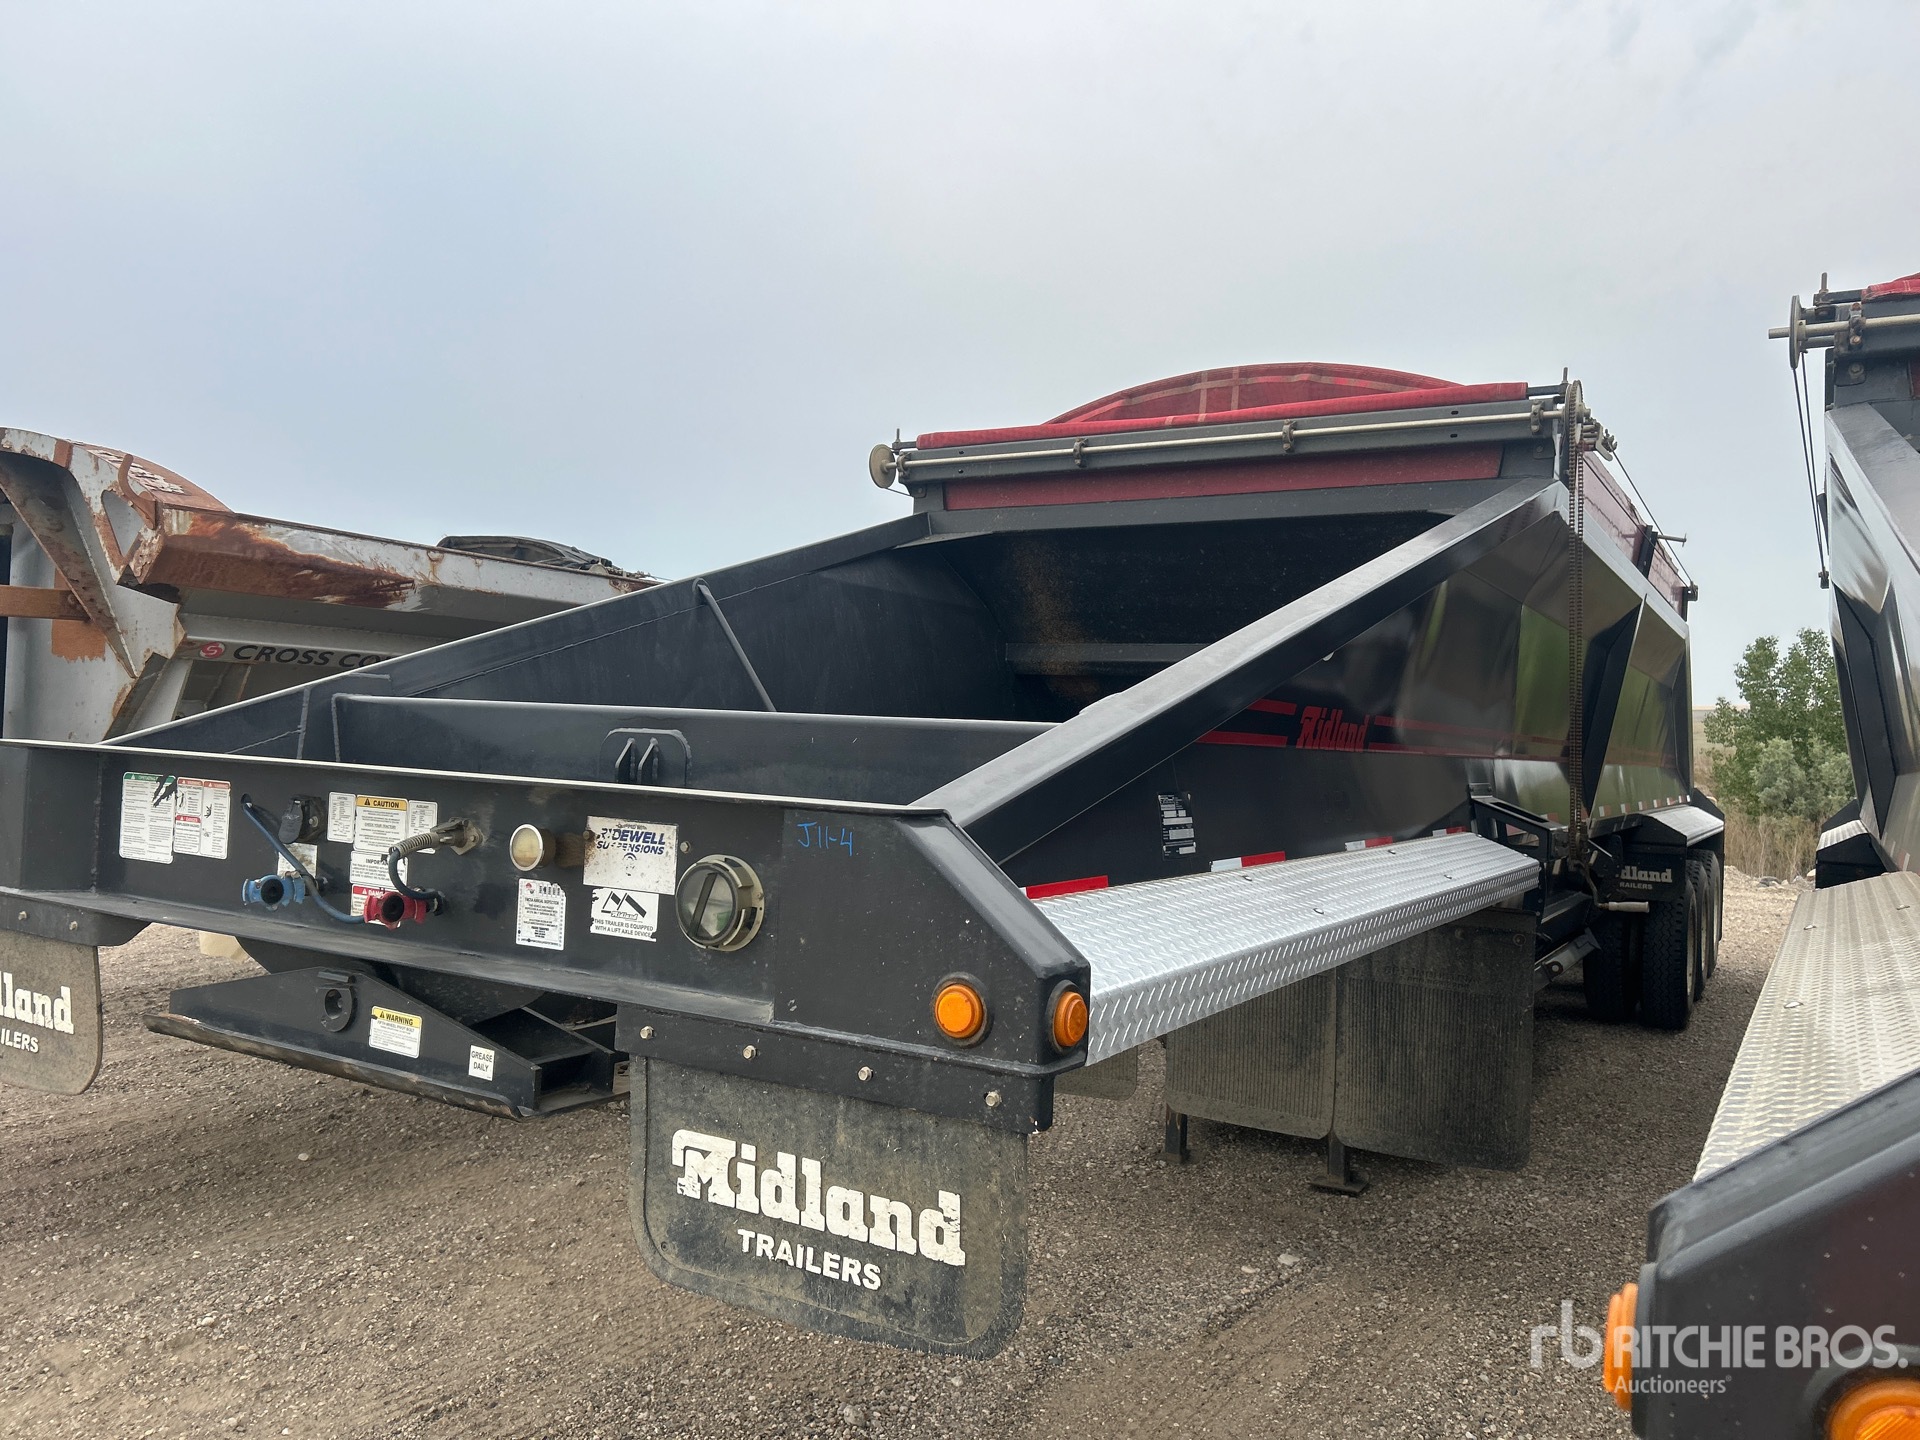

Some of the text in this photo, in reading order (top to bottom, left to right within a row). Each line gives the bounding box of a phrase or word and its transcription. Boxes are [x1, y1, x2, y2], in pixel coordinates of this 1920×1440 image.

[233, 644, 334, 666] CROSS
[1296, 705, 1370, 753] Midland
[373, 800, 399, 809] CAUTION
[1619, 865, 1673, 883] dland
[1619, 882, 1653, 890] RAILERS
[0, 971, 75, 1035] land
[385, 1012, 414, 1026] WARNING
[0, 1028, 39, 1053] ILERS
[471, 1050, 493, 1063] GREASE
[473, 1061, 489, 1072] DAILY
[671, 1128, 966, 1267] Midland
[737, 1228, 882, 1291] TRAILERS
